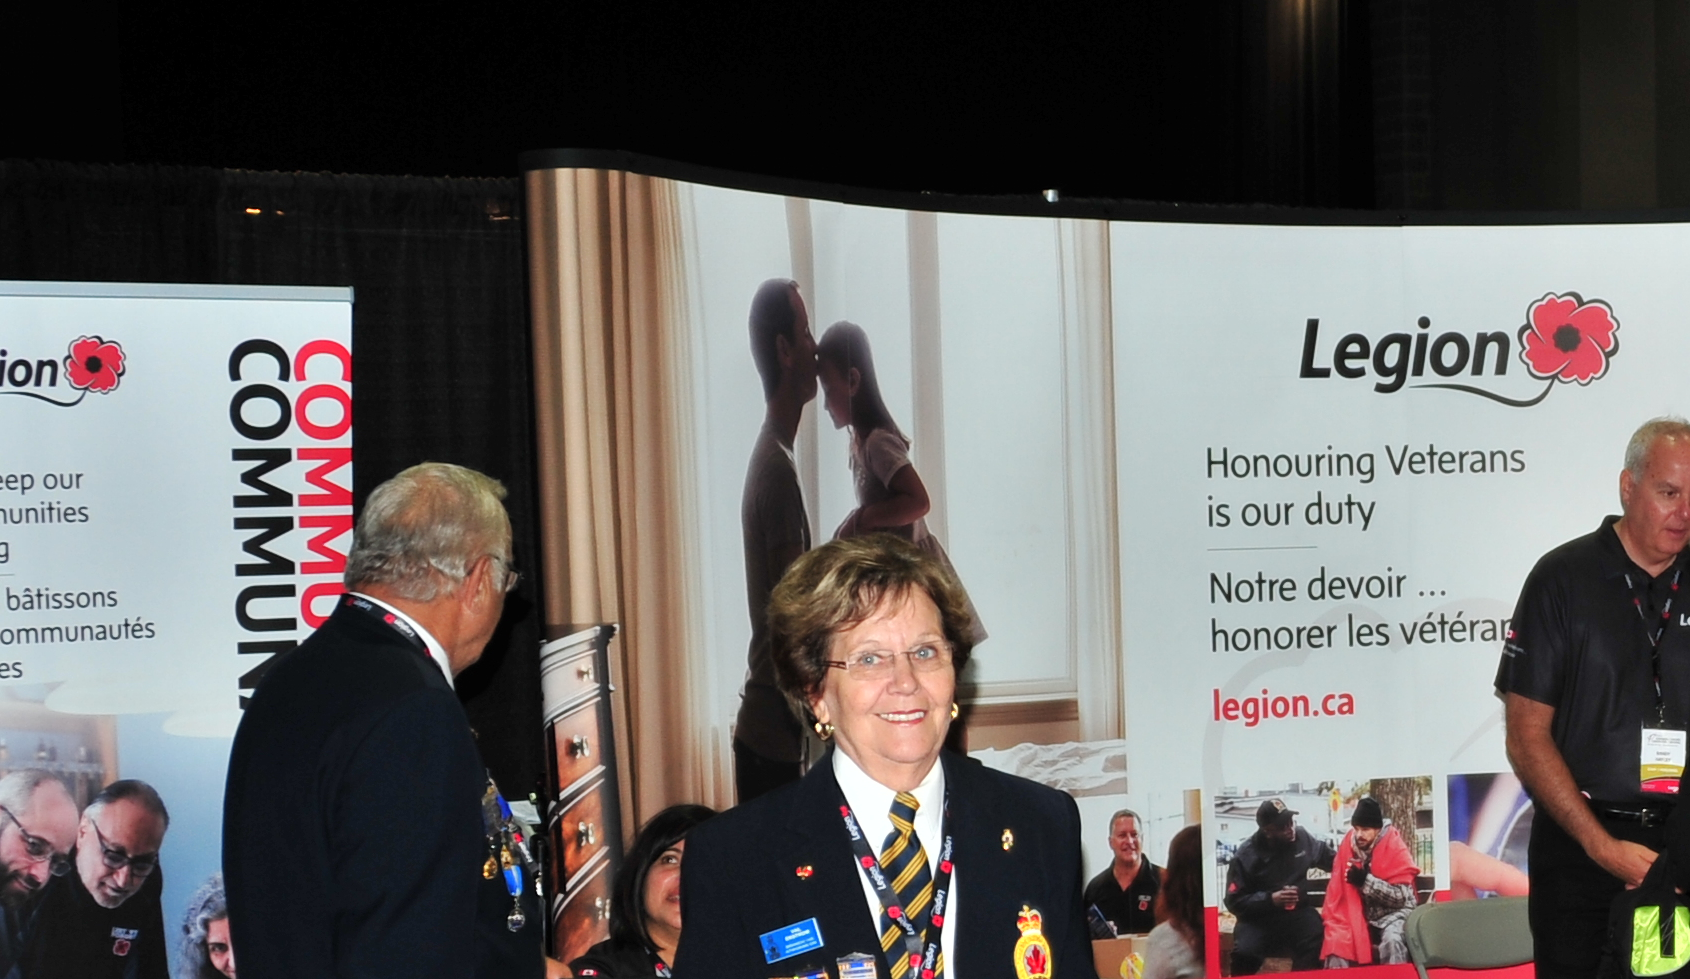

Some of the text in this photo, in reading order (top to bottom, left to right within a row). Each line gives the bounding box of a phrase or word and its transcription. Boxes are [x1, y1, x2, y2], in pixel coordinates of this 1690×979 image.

[1299, 316, 1511, 394] Legion
[43, 472, 84, 490] our
[1207, 443, 1526, 484] Honouring Veterans
[294, 339, 354, 632] COMMU
[1207, 490, 1376, 532] is our duty
[6, 587, 118, 611] bâtissons
[1210, 571, 1298, 604] Notre
[1307, 565, 1407, 601] devoir
[0, 616, 156, 646] ommunautés
[1211, 617, 1338, 652] honorer
[1348, 613, 1390, 647] les
[1213, 688, 1355, 727] legion.ca
[869, 866, 886, 890] Legion
[935, 888, 946, 915] Legion
[925, 942, 937, 969] Legion
